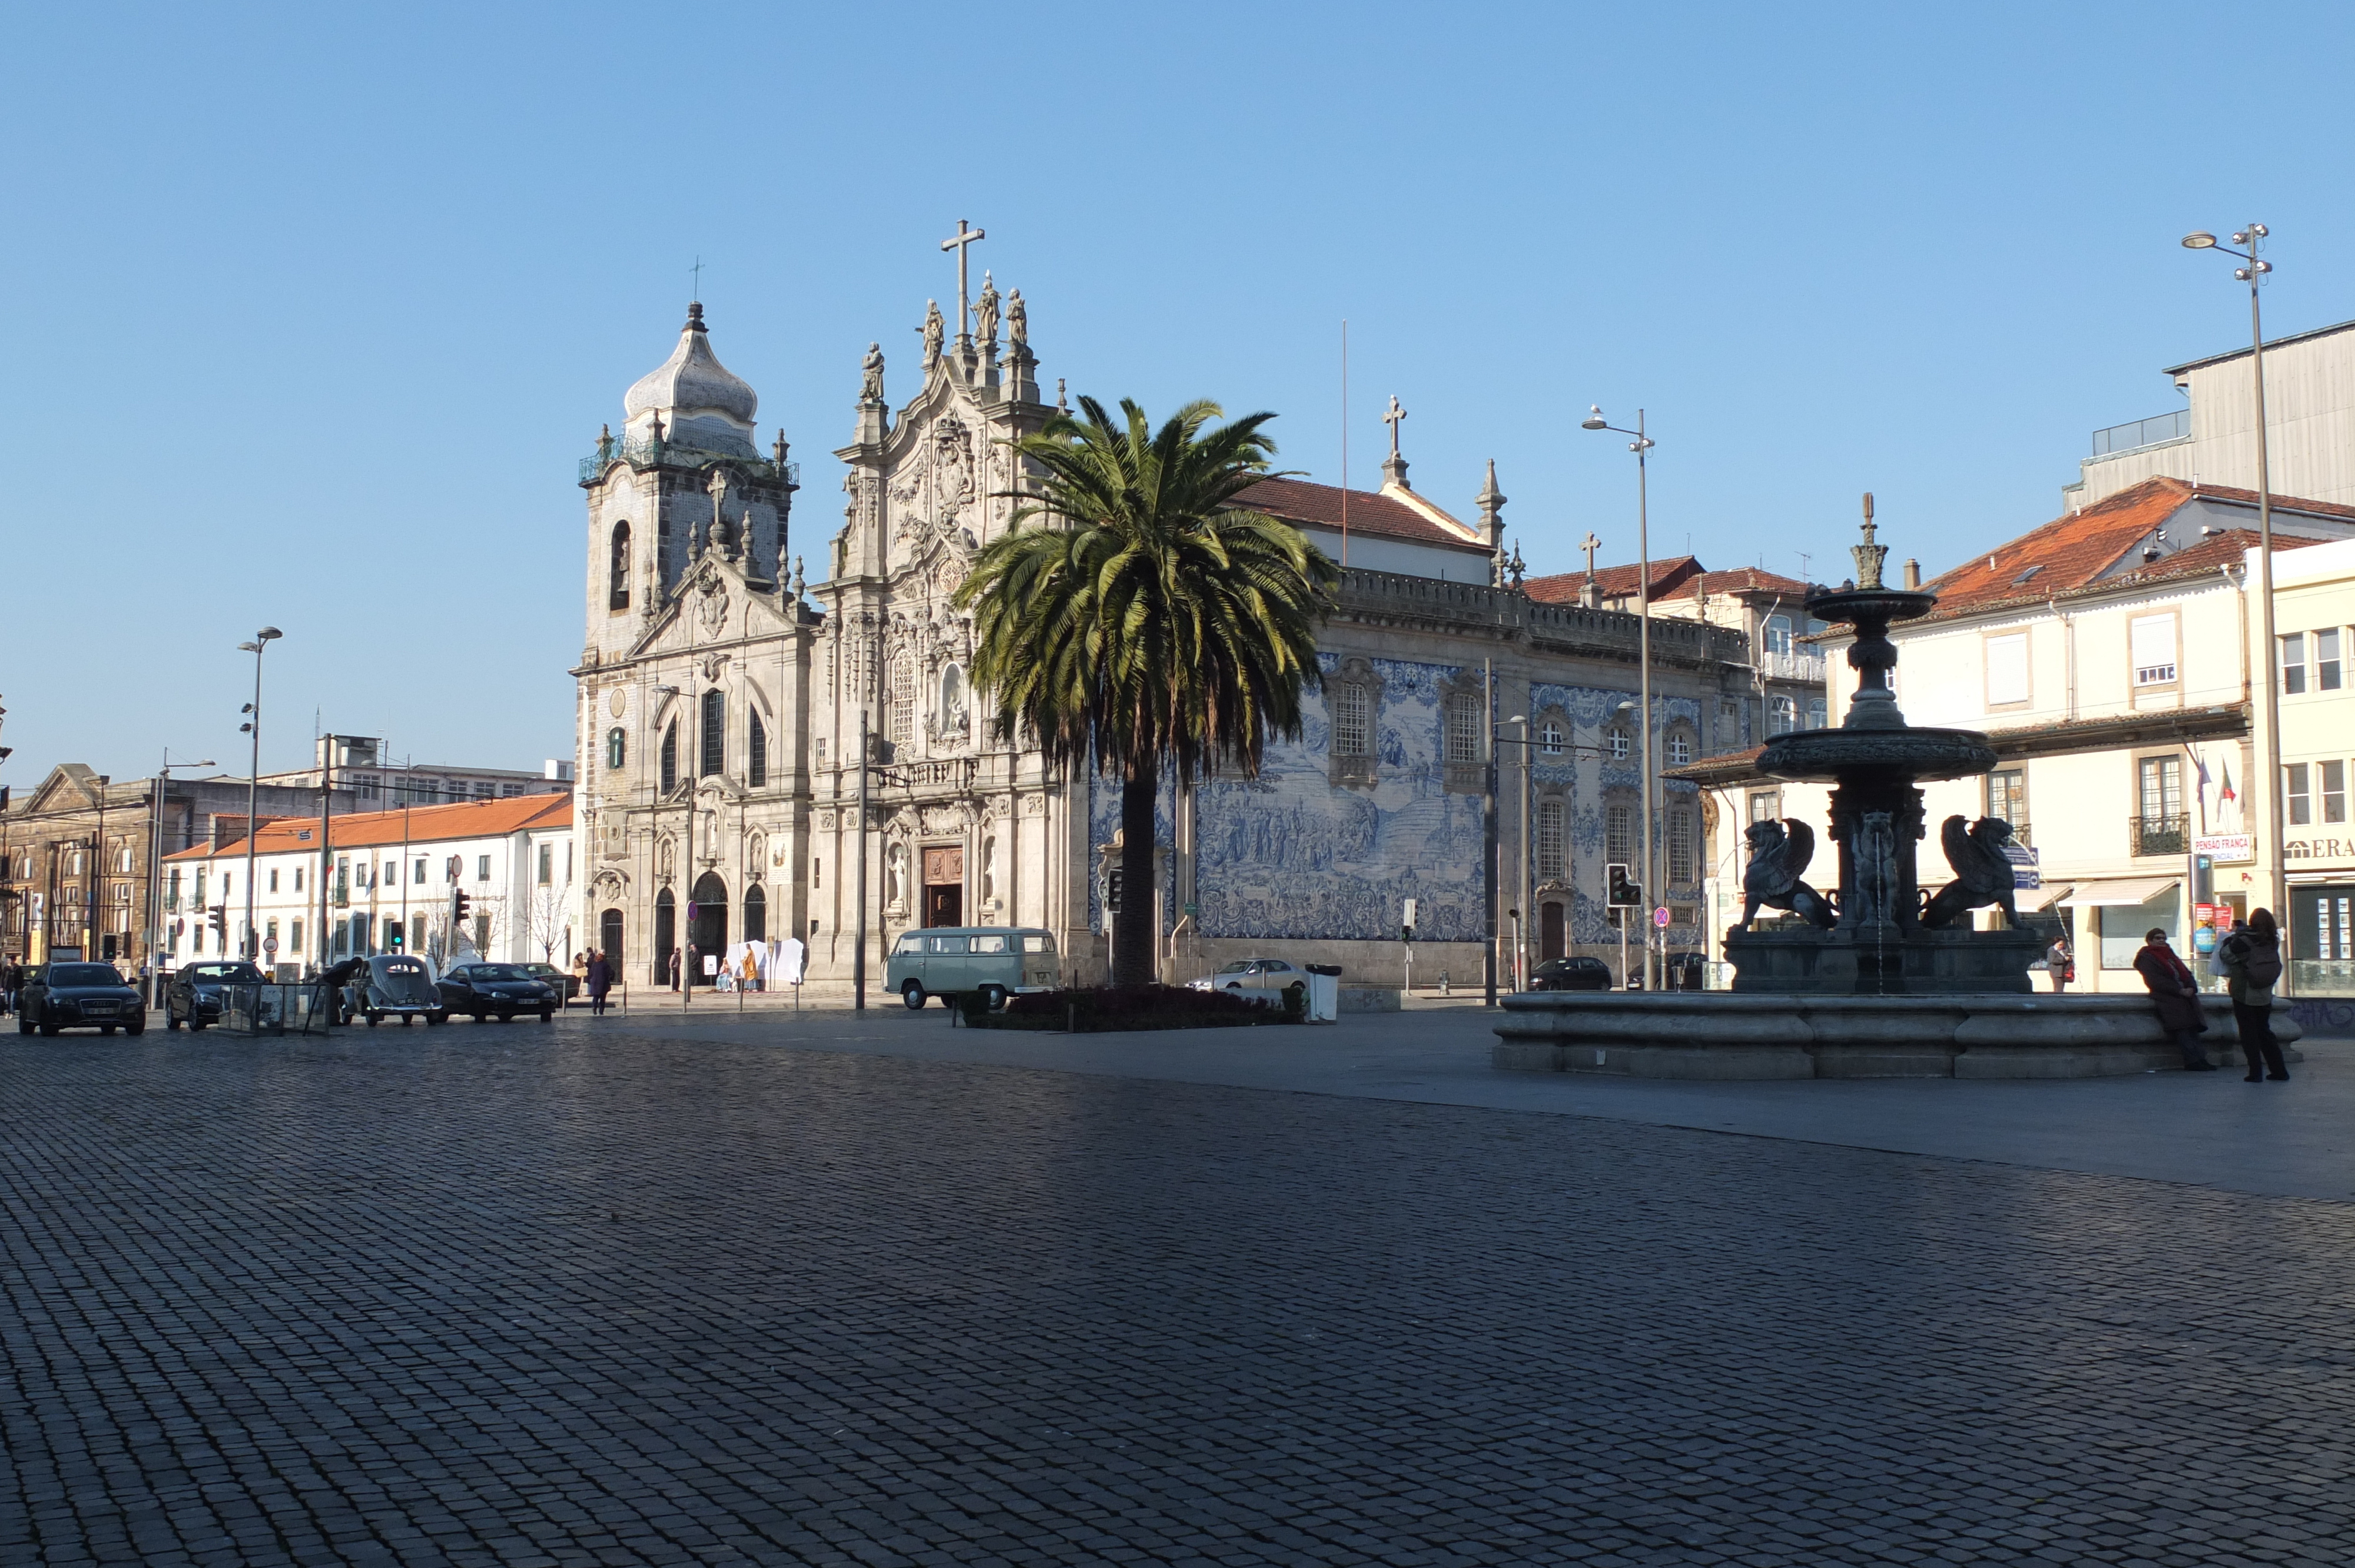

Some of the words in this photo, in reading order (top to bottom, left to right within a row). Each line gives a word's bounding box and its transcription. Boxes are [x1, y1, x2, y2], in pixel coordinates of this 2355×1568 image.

[2195, 838, 2220, 851] PENSÃO
[2221, 838, 2248, 851] FRANÇA
[2311, 838, 2355, 858] ERA
